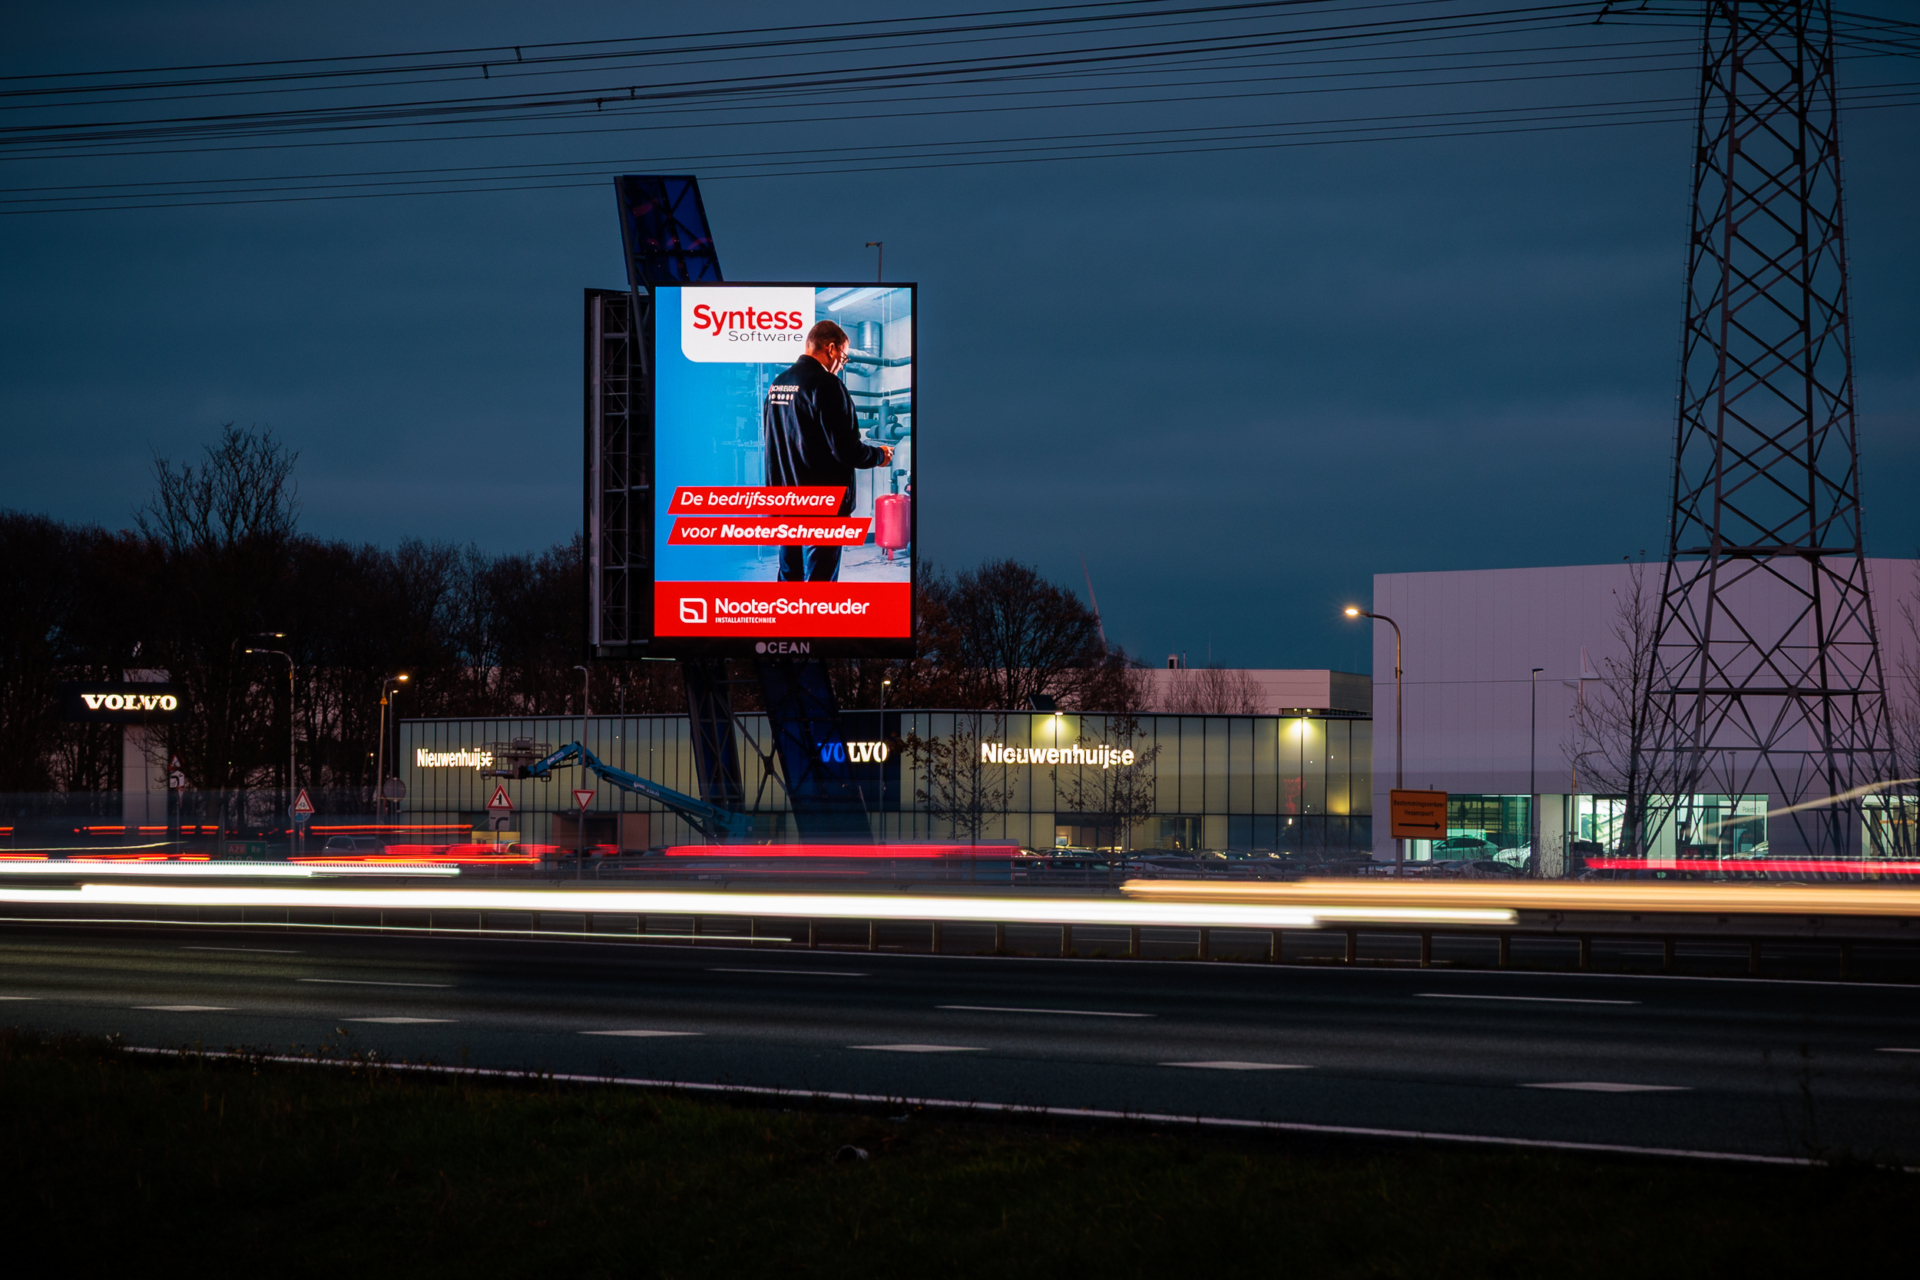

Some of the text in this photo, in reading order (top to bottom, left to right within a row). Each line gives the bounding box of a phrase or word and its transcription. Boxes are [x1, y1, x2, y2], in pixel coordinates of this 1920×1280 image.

[693, 304, 803, 336] Syntess
[728, 331, 804, 342] Software
[680, 491, 836, 509] De bedrijfssoftware
[681, 524, 863, 539] voor NooterSchreuder
[715, 598, 870, 615] NooterSchreuder
[755, 642, 810, 654] OCEAN
[81, 694, 178, 711] VOLVO
[417, 747, 493, 771] Nieuwenhuijse
[817, 741, 888, 763] VOLVO
[981, 743, 1135, 769] Nieuwenhuijse
[228, 845, 245, 853] A28
